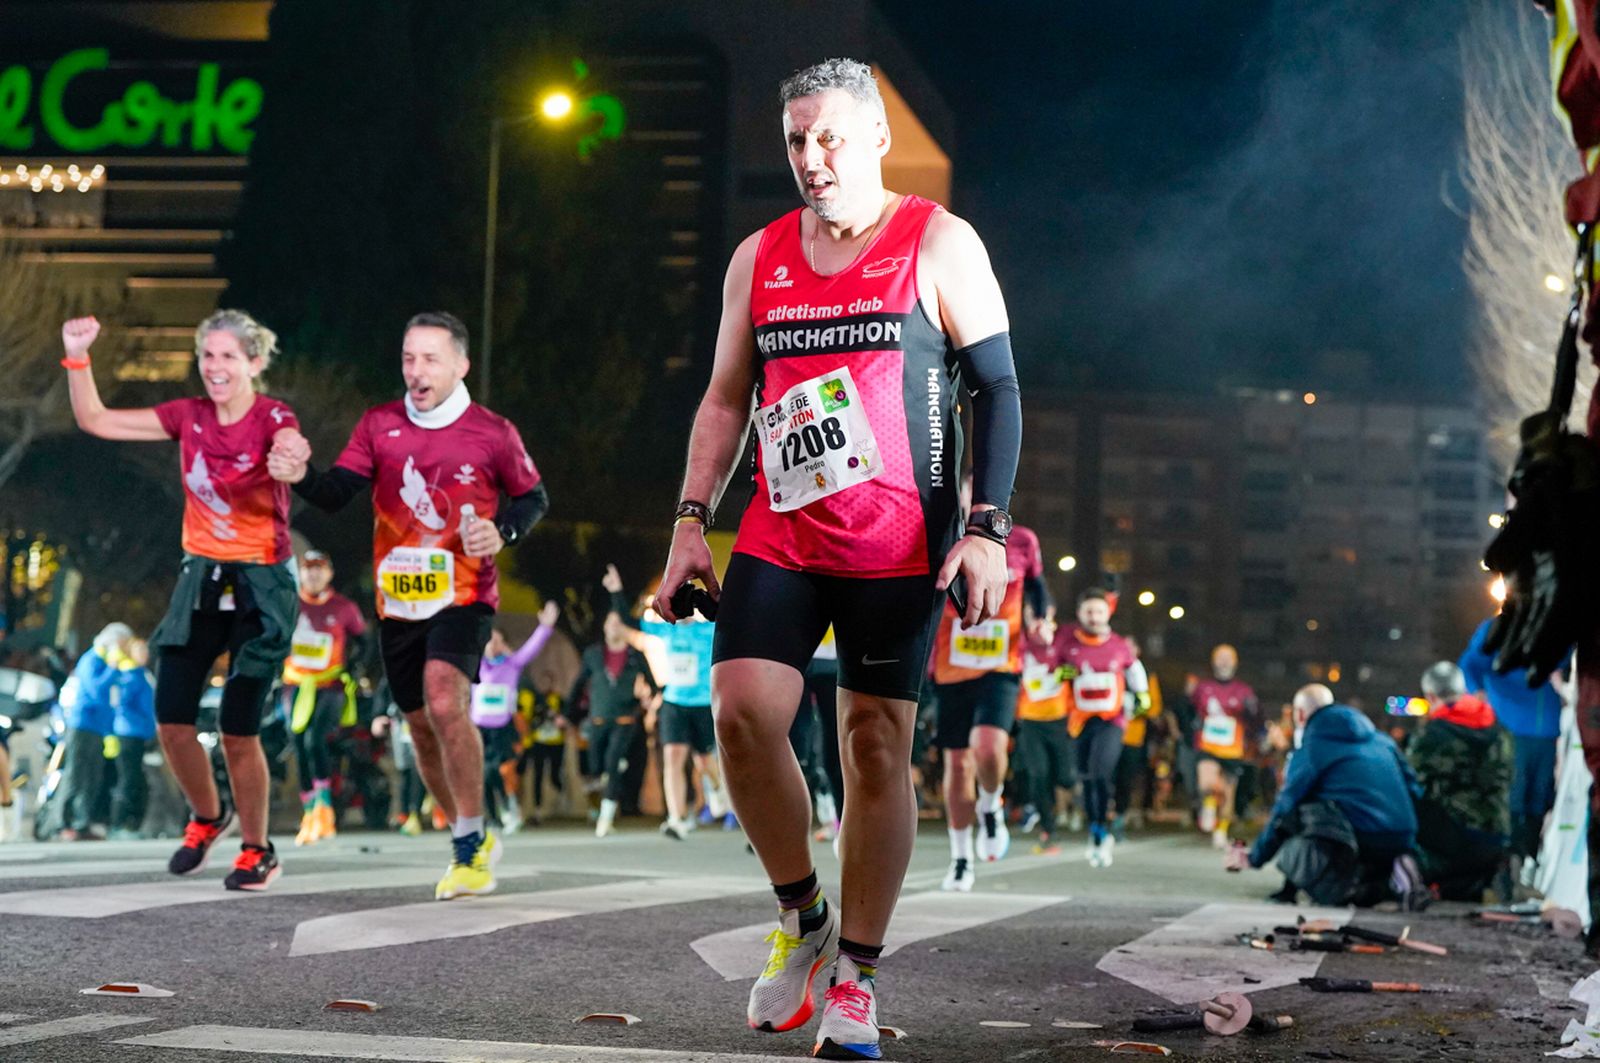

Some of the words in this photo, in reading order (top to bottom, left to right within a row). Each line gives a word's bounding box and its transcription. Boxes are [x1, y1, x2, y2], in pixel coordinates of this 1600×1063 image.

[40, 47, 264, 154] Corte
[764, 279, 794, 289] VIATOR
[767, 303, 843, 322] atletismo
[848, 296, 883, 314] club
[795, 395, 810, 410] DE
[927, 367, 943, 487] MANCHATHON
[777, 416, 847, 472] 7208
[804, 460, 826, 473] Pedro
[392, 573, 437, 595] 1646
